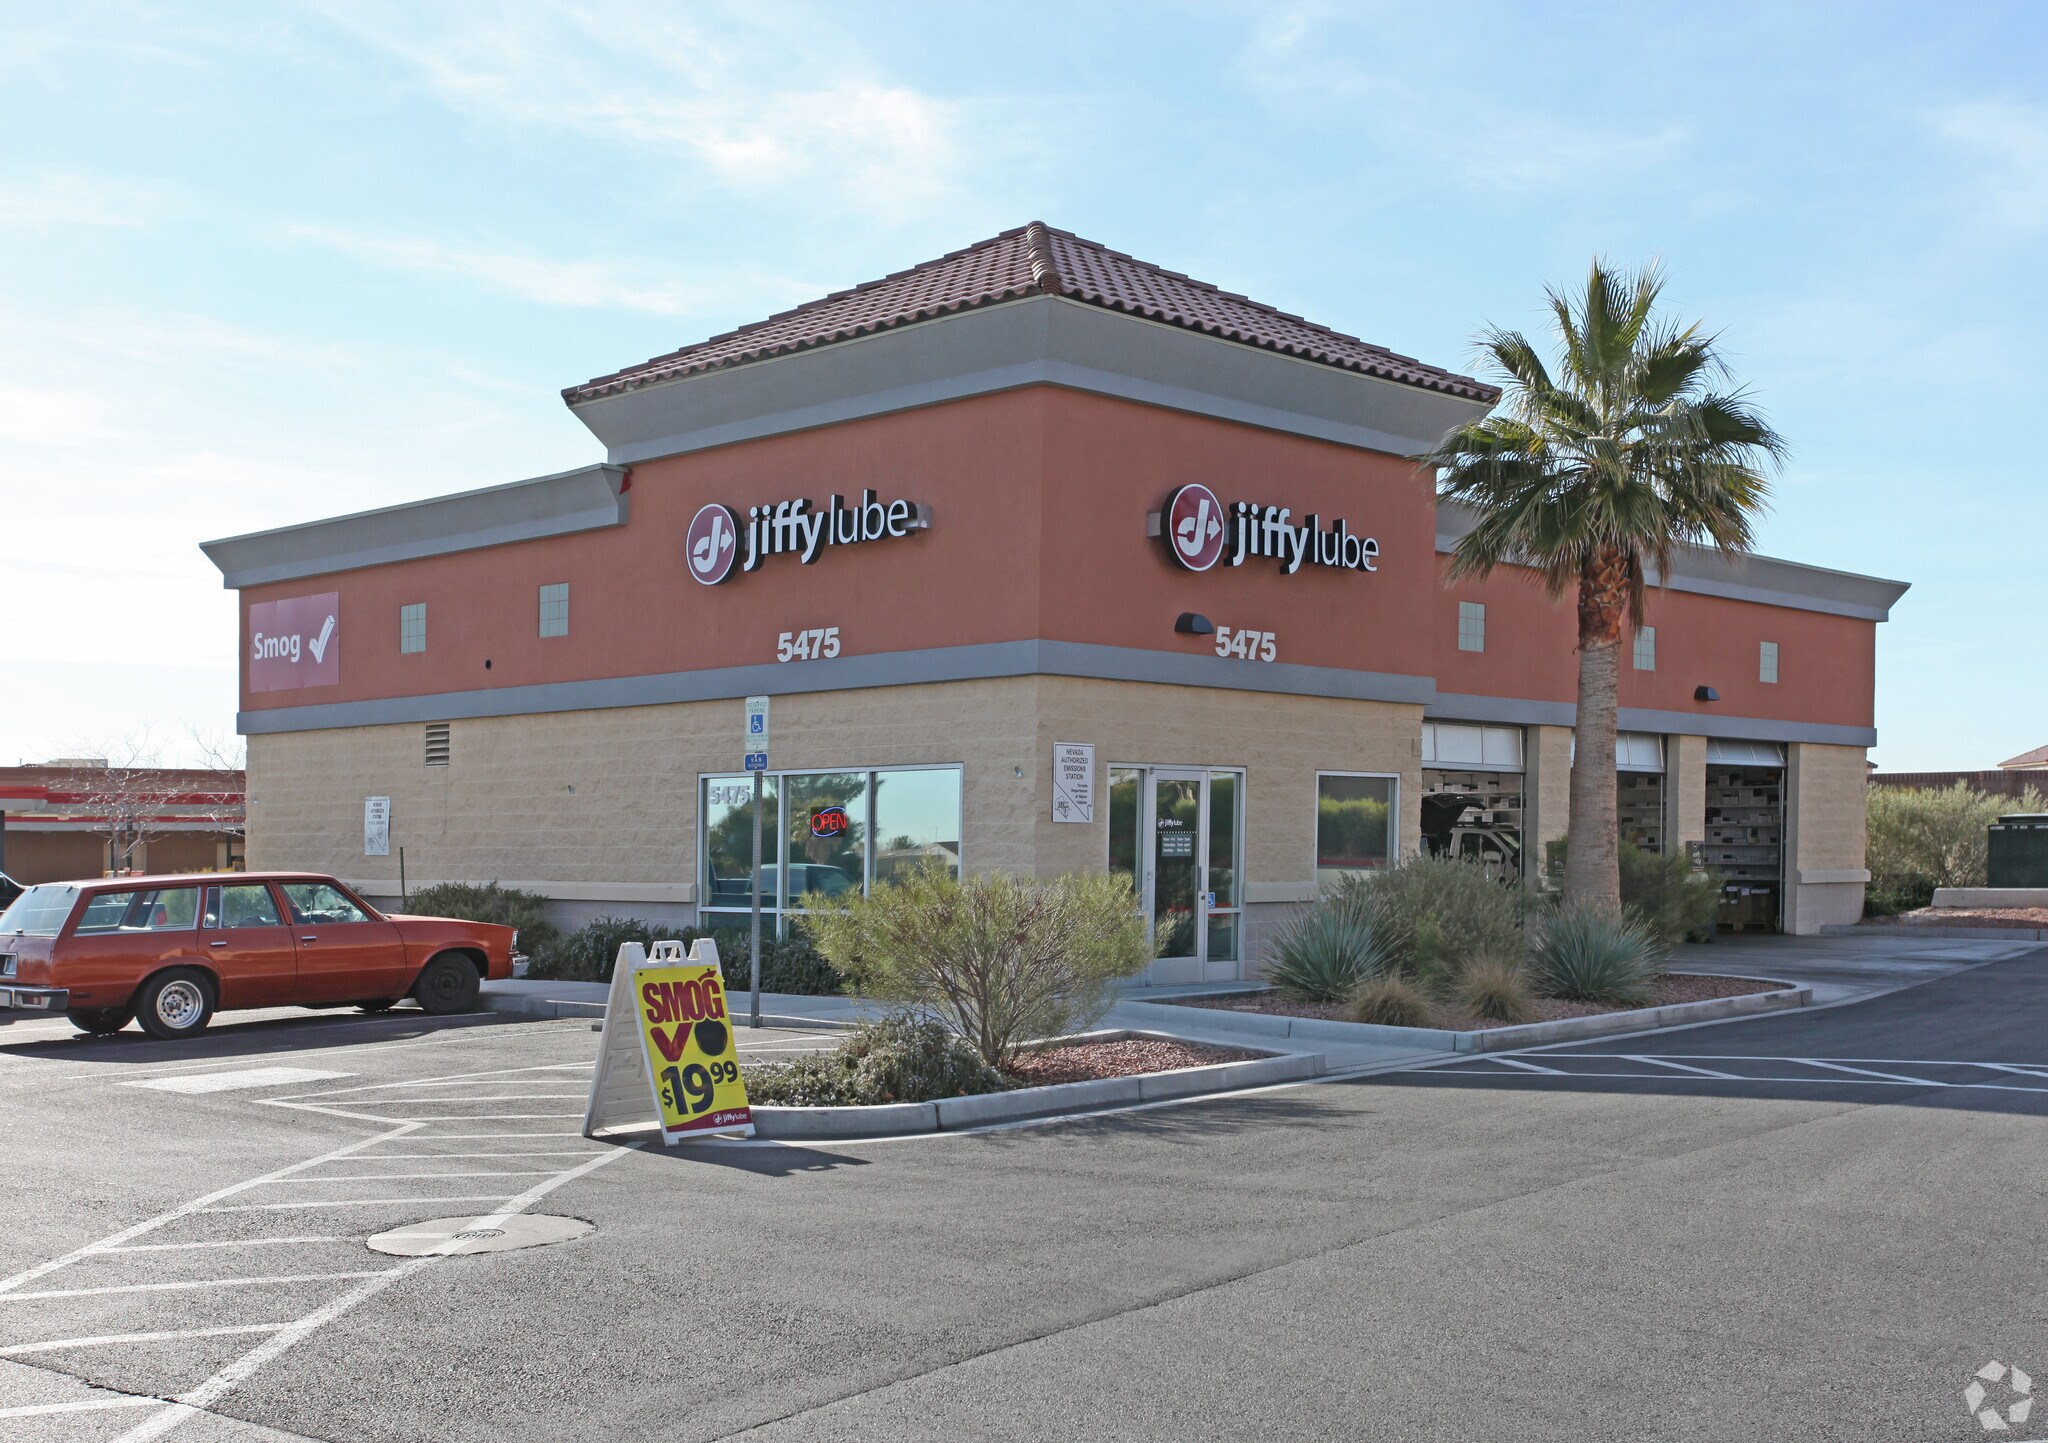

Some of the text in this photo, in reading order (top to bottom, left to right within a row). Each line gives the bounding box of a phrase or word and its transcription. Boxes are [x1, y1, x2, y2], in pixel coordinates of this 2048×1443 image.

[254, 632, 300, 663] Smog
[776, 626, 841, 663] 5475
[1214, 625, 1277, 663] 5475
[1061, 756, 1089, 764] AUTHORIZED
[1066, 748, 1084, 756] NEVADA
[1063, 764, 1086, 772] EMISSIONS
[709, 785, 751, 805] 5475
[811, 813, 847, 831] OPEN
[642, 978, 725, 1024] SMOG
